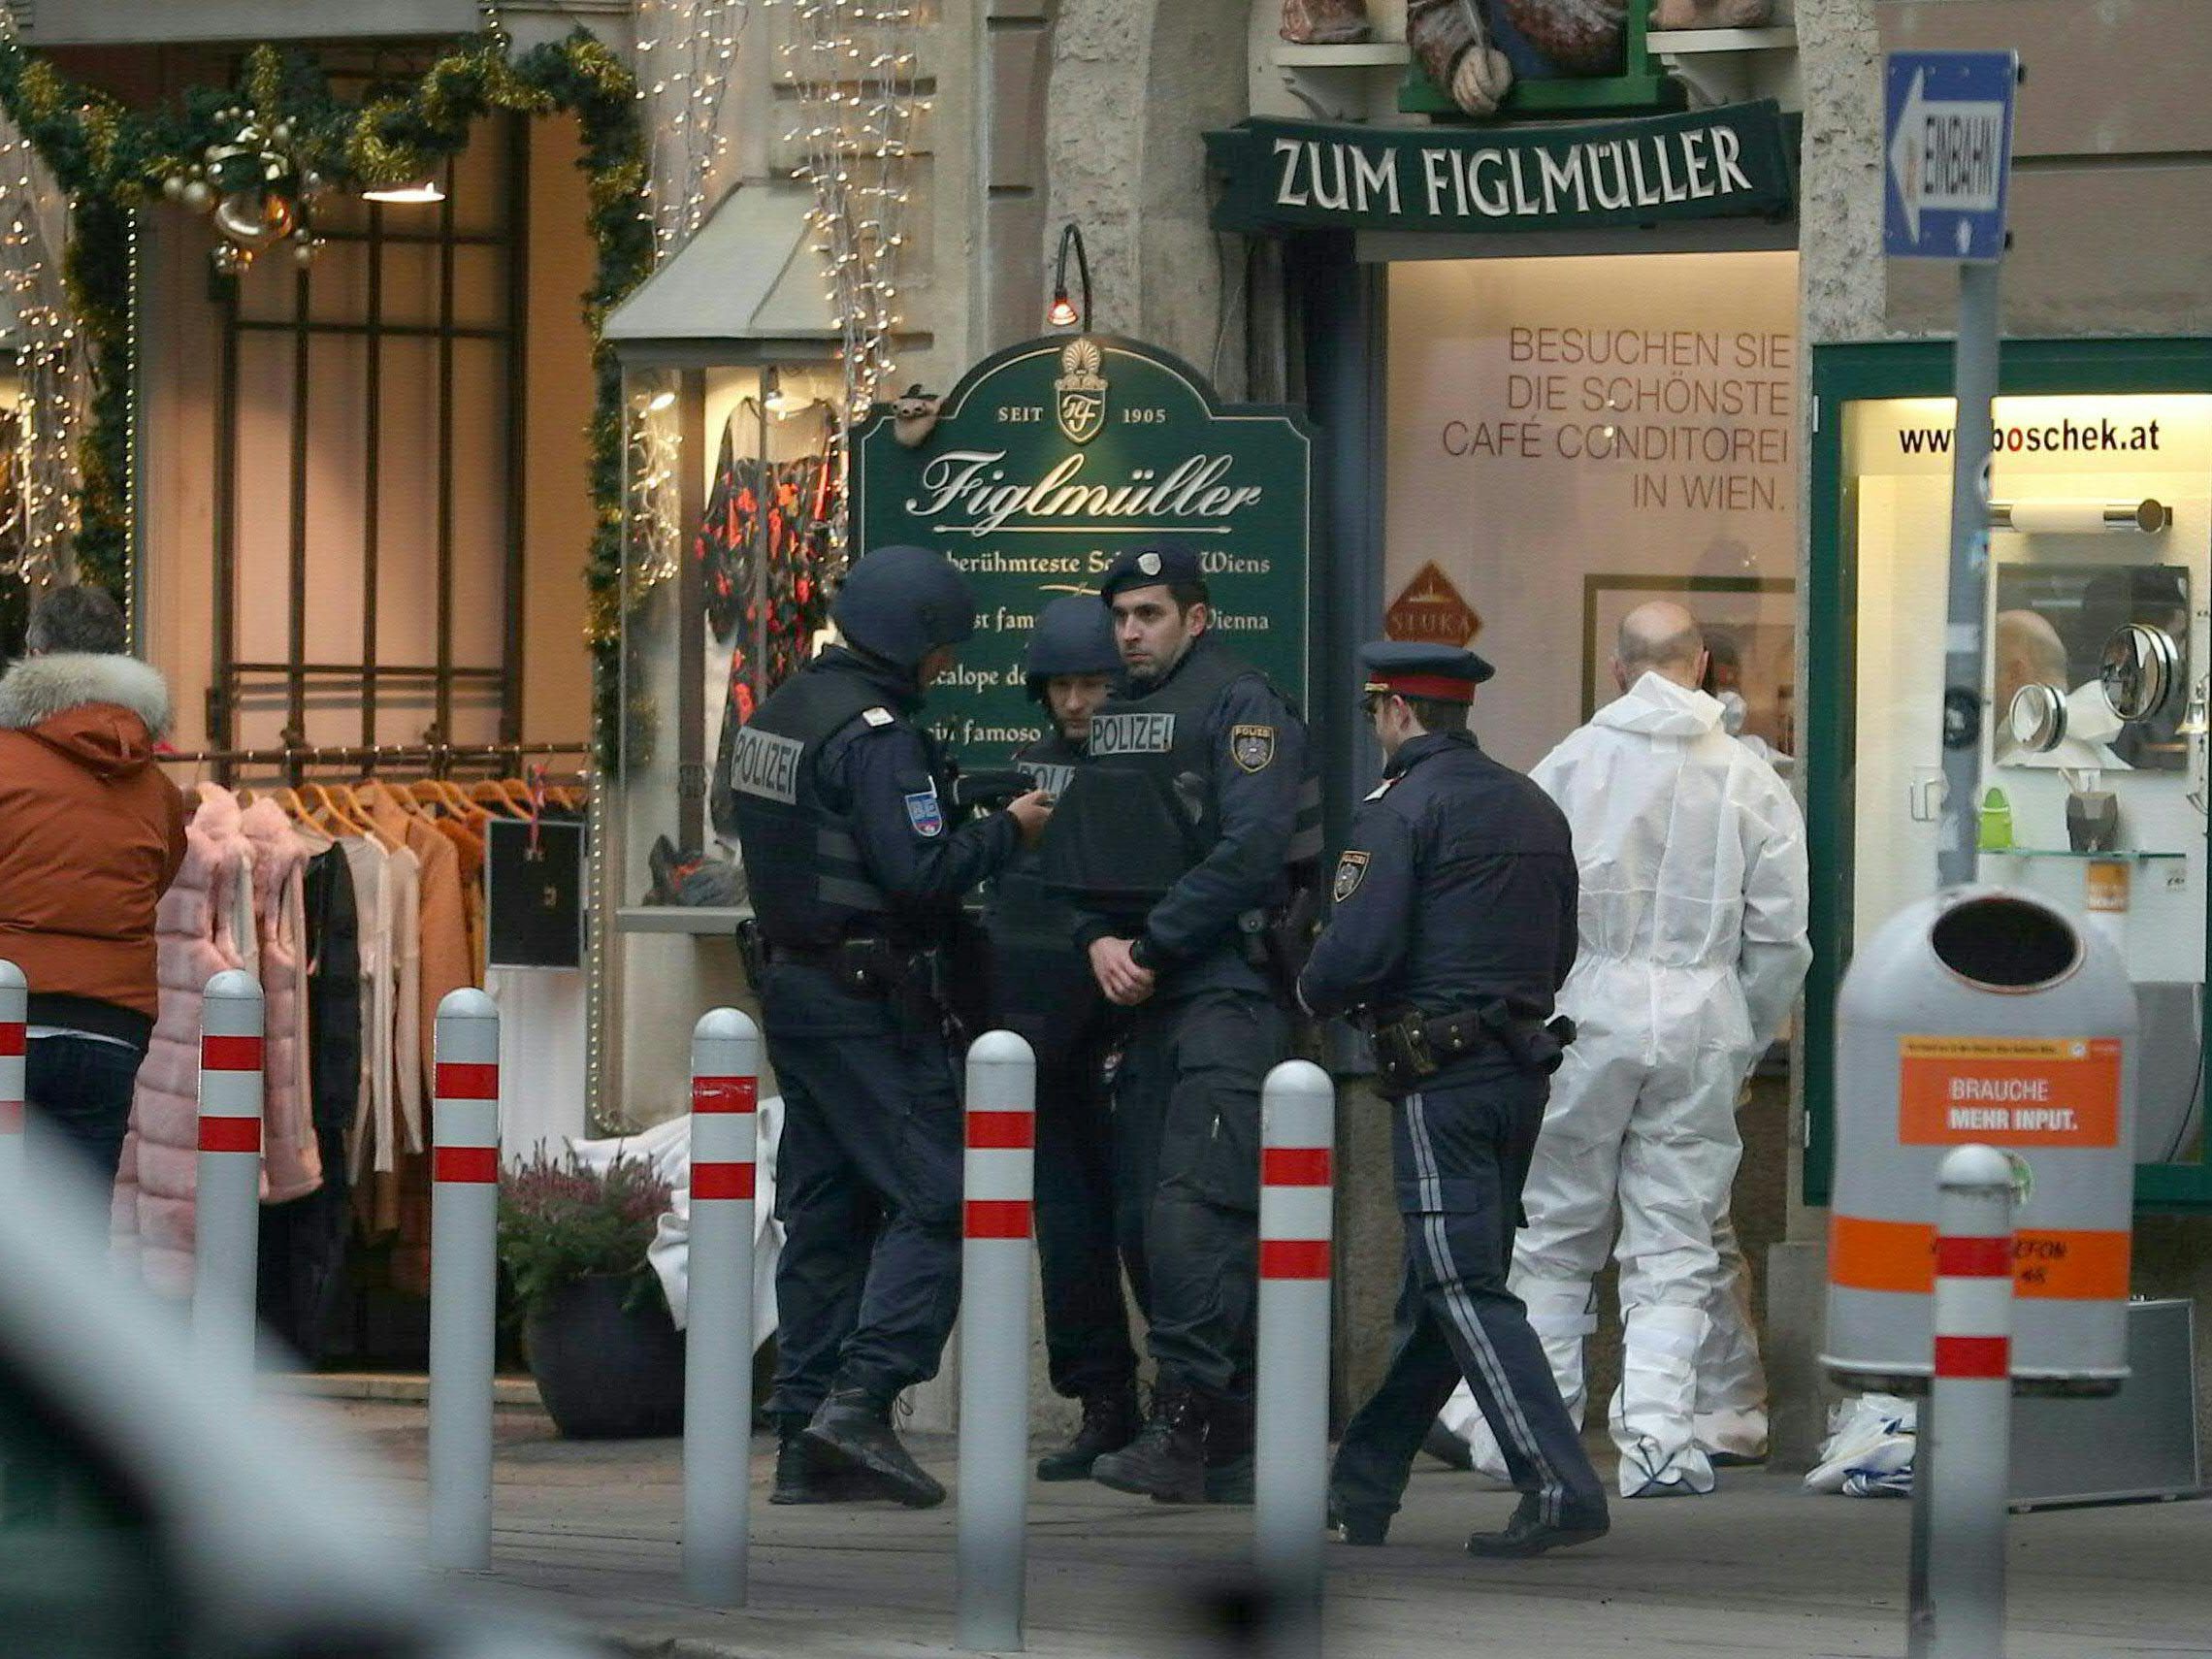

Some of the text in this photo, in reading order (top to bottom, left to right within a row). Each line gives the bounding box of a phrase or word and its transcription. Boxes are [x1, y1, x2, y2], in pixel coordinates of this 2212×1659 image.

[1272, 126, 1753, 216] ZUM FIGLMÜLLER
[1510, 327, 1791, 369] BESUCHEN SIE
[1508, 370, 1790, 416] DIE SCHÖNSTE
[998, 407, 1166, 424] SEIT 1905
[1443, 415, 1789, 463] CAFÉ CONDITOREI
[1899, 418, 2160, 453] wwboschek.at
[906, 450, 1262, 537] Figlmüller
[1634, 474, 1785, 511] IN WIEN.
[1200, 550, 1271, 573] Wiens
[995, 606, 1038, 634] fam
[963, 719, 1042, 746] famoso
[1092, 714, 1171, 754] POLIZEI
[734, 732, 798, 795] POLIZEI
[1949, 1077, 2049, 1102] BRAUCHE
[1949, 1107, 2079, 1131] MEHR INPUT.
